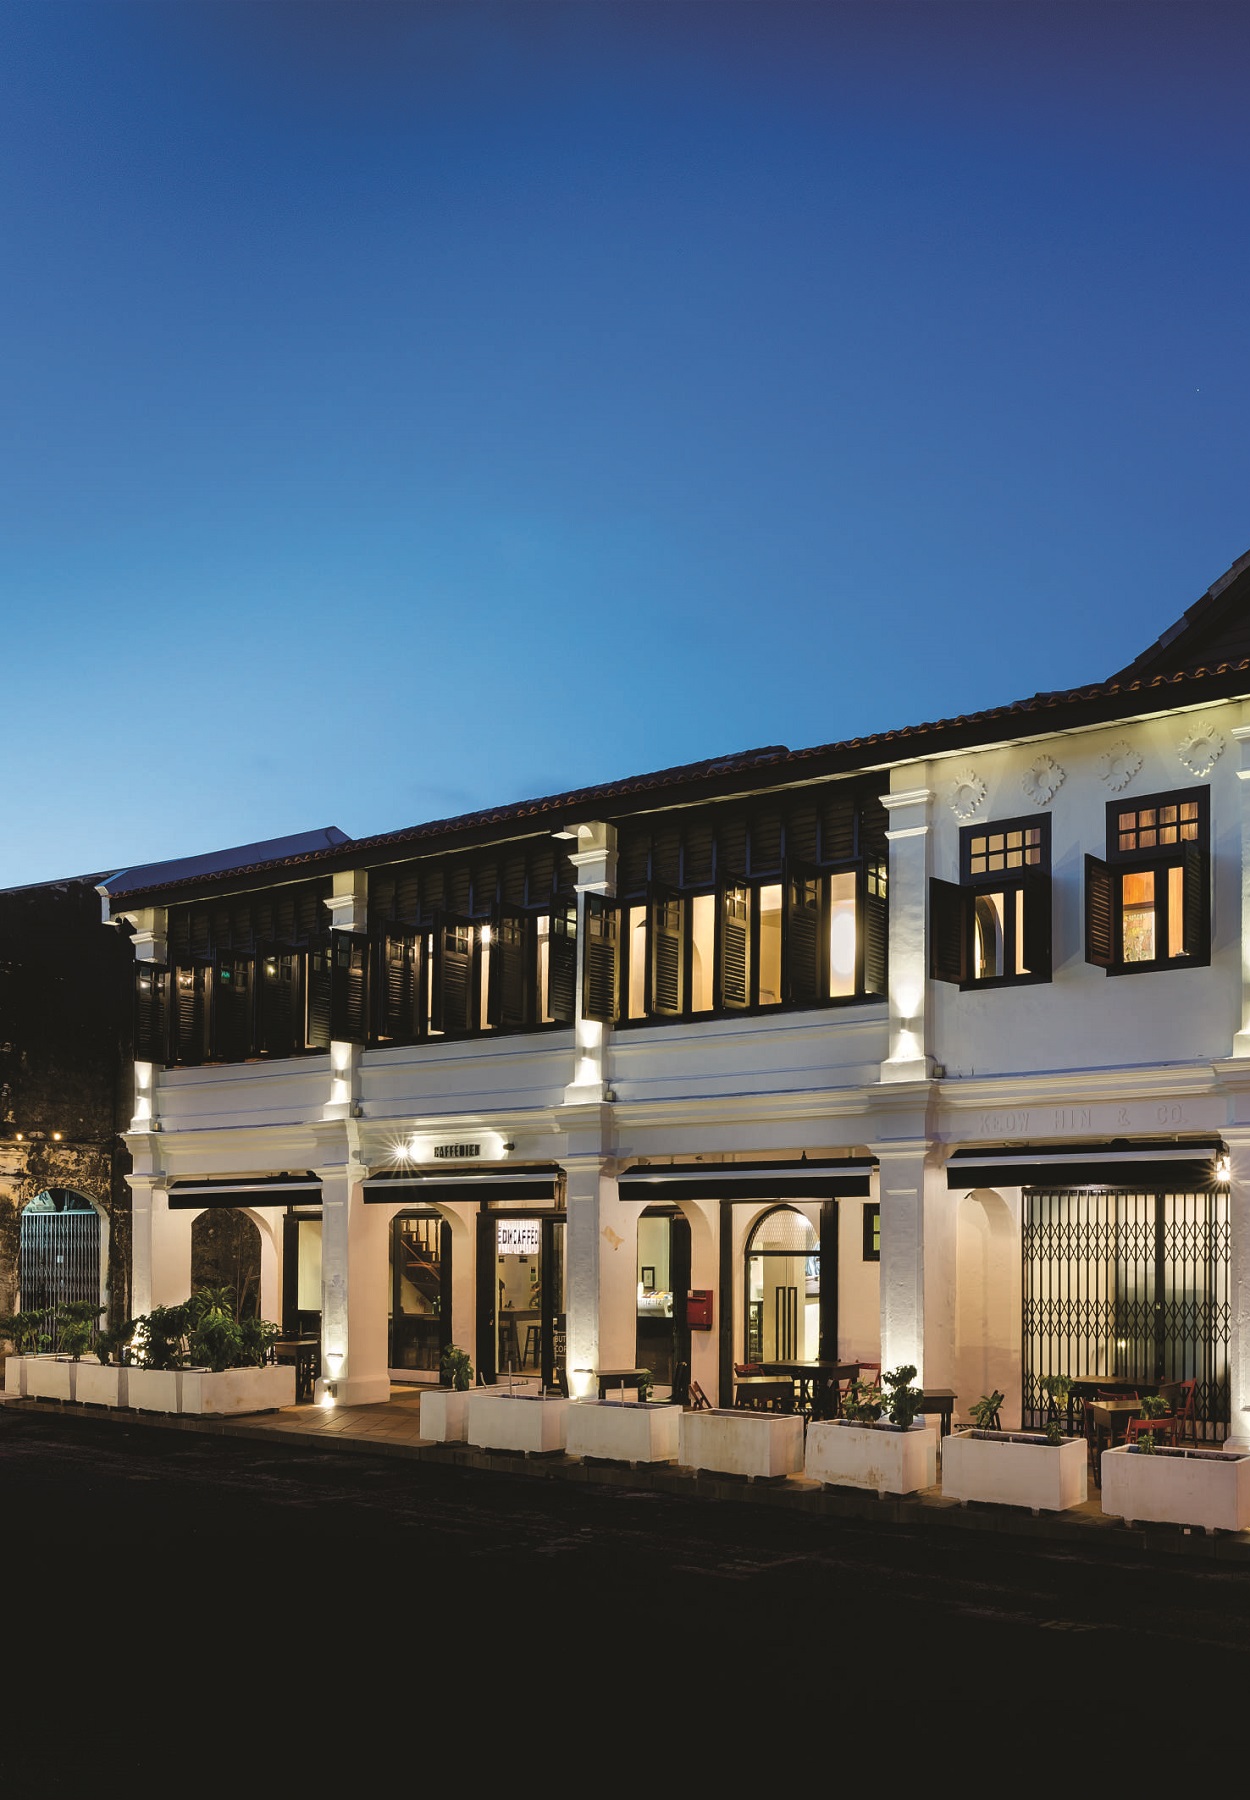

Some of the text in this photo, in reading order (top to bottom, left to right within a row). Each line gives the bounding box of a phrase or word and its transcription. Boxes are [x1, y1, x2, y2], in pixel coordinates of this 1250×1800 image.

[1054, 1109, 1092, 1130] HIN
[1117, 1107, 1130, 1127] &
[555, 1345, 566, 1353] COF
